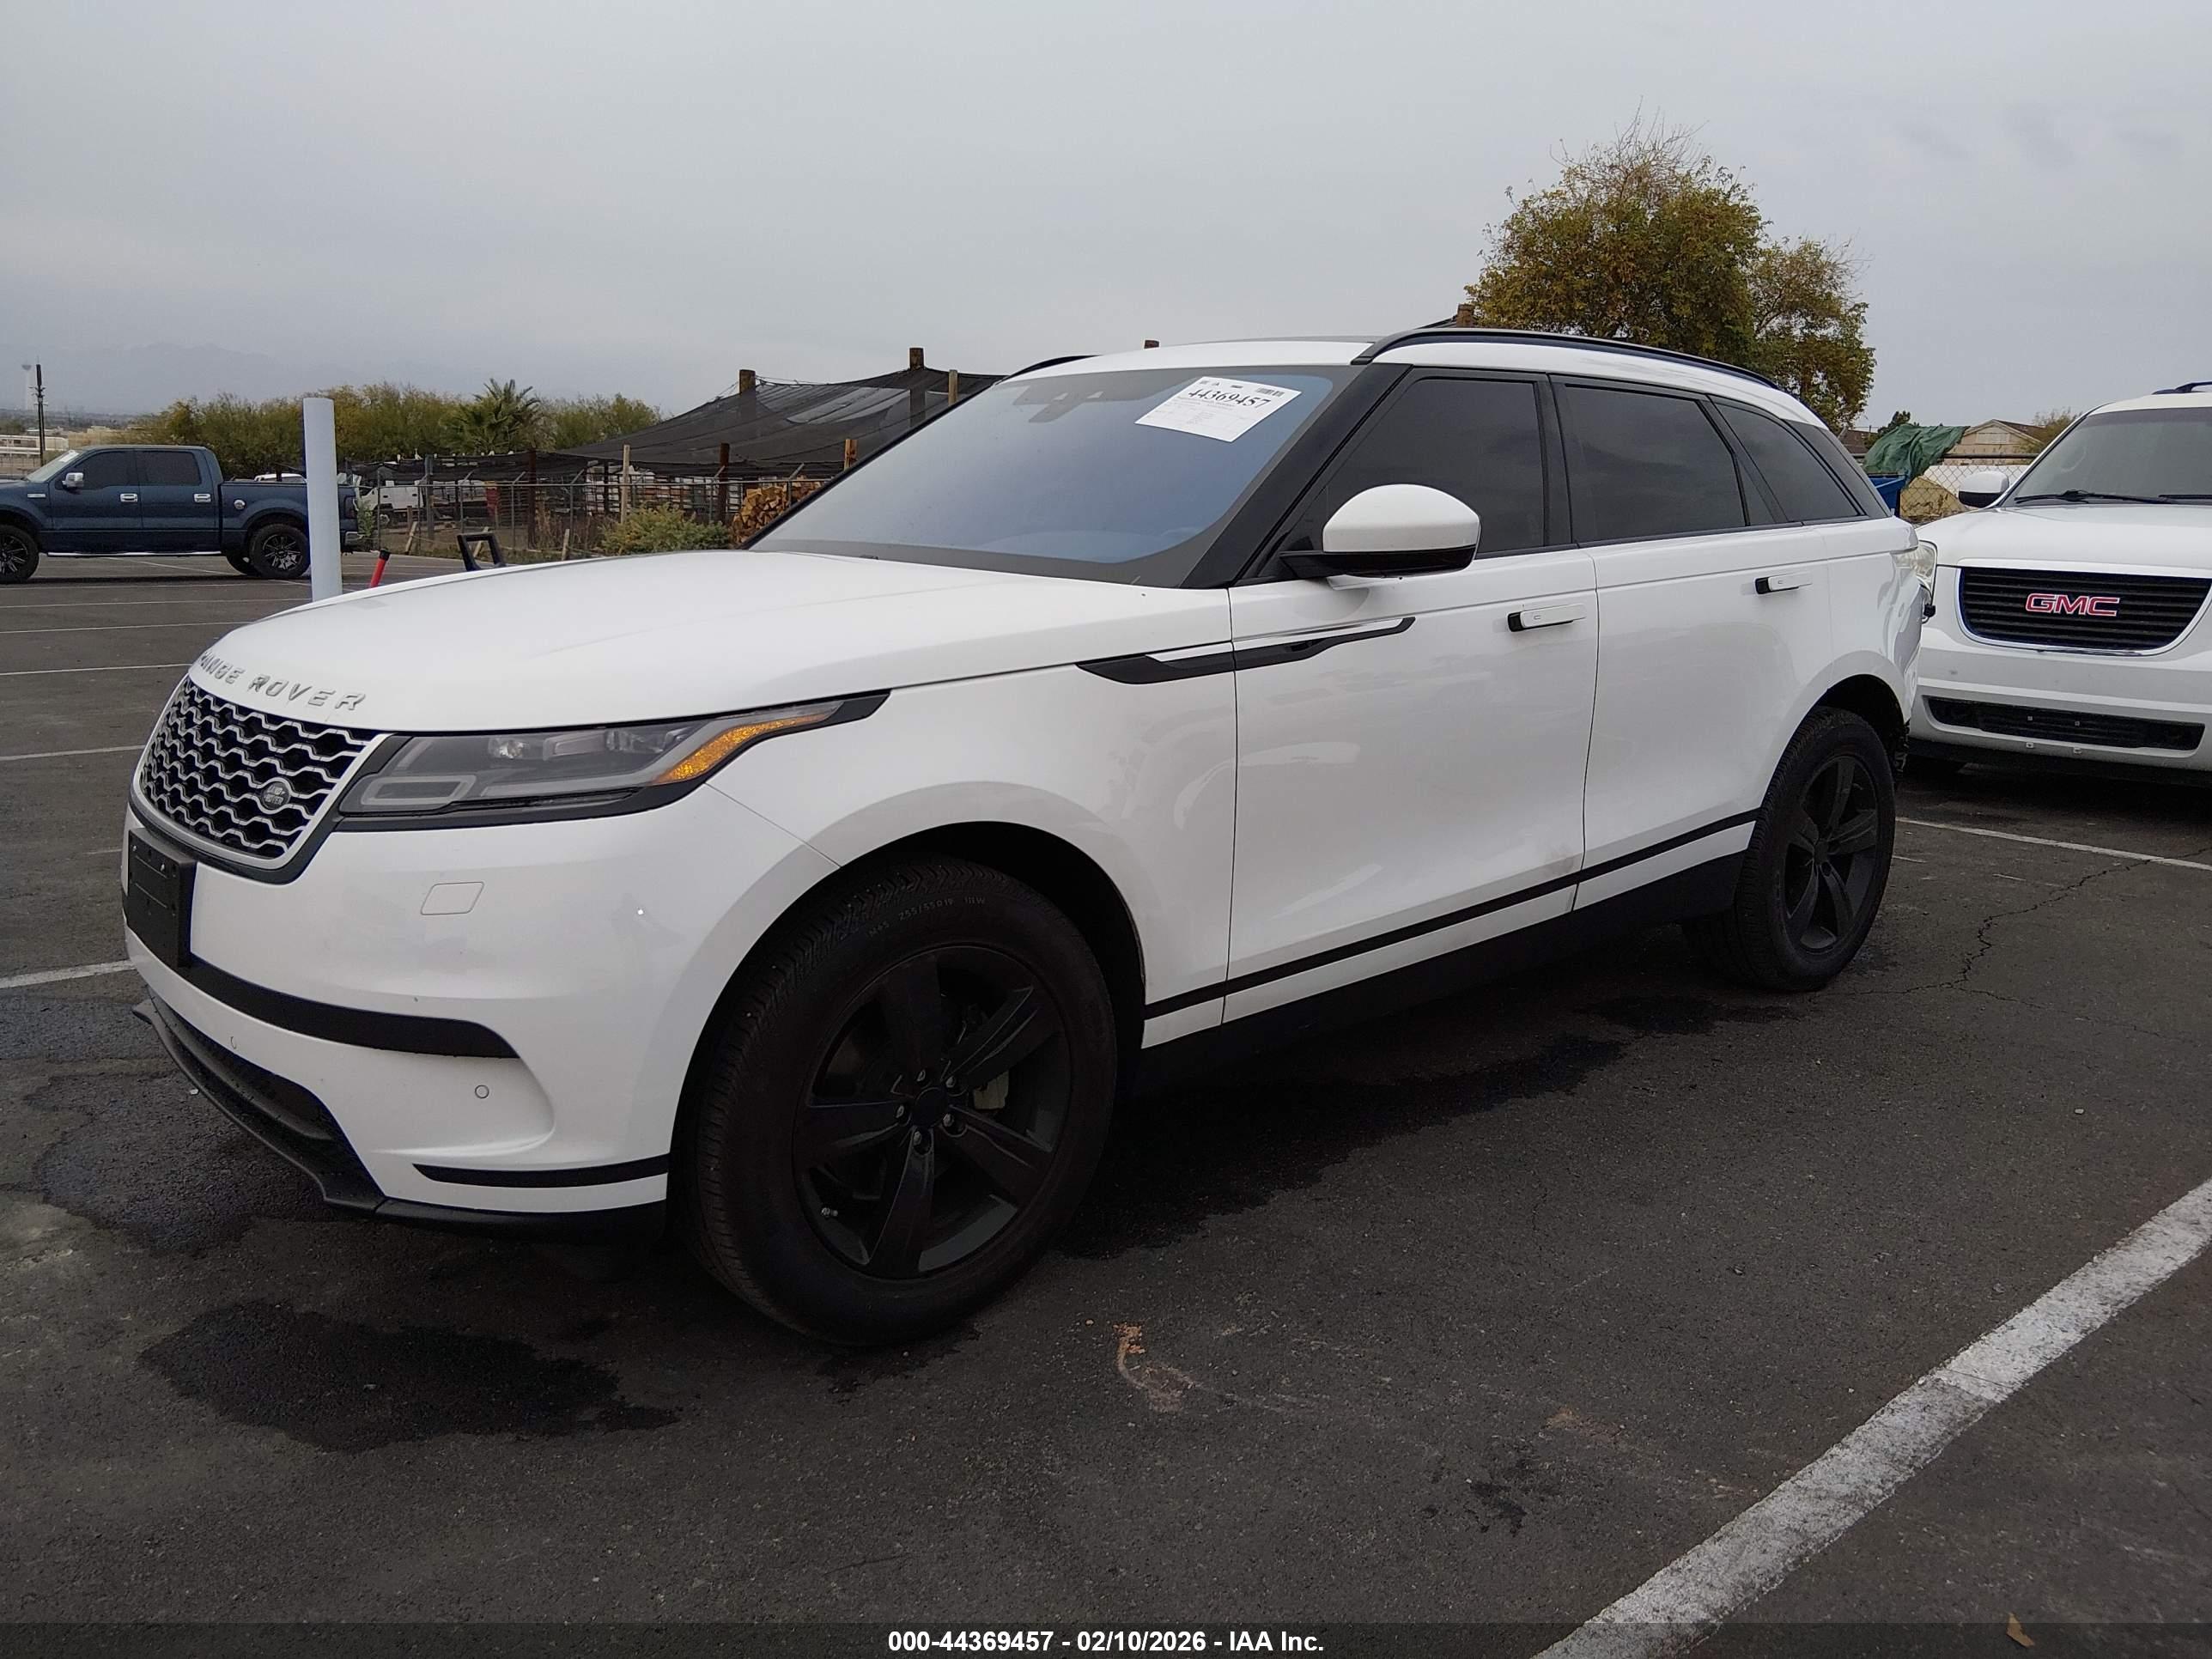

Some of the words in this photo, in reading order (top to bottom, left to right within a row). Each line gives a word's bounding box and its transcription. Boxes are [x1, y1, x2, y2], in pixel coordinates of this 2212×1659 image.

[1188, 388, 1271, 409] 44369457
[2025, 592, 2120, 617] GMC
[248, 673, 367, 711] ROVER
